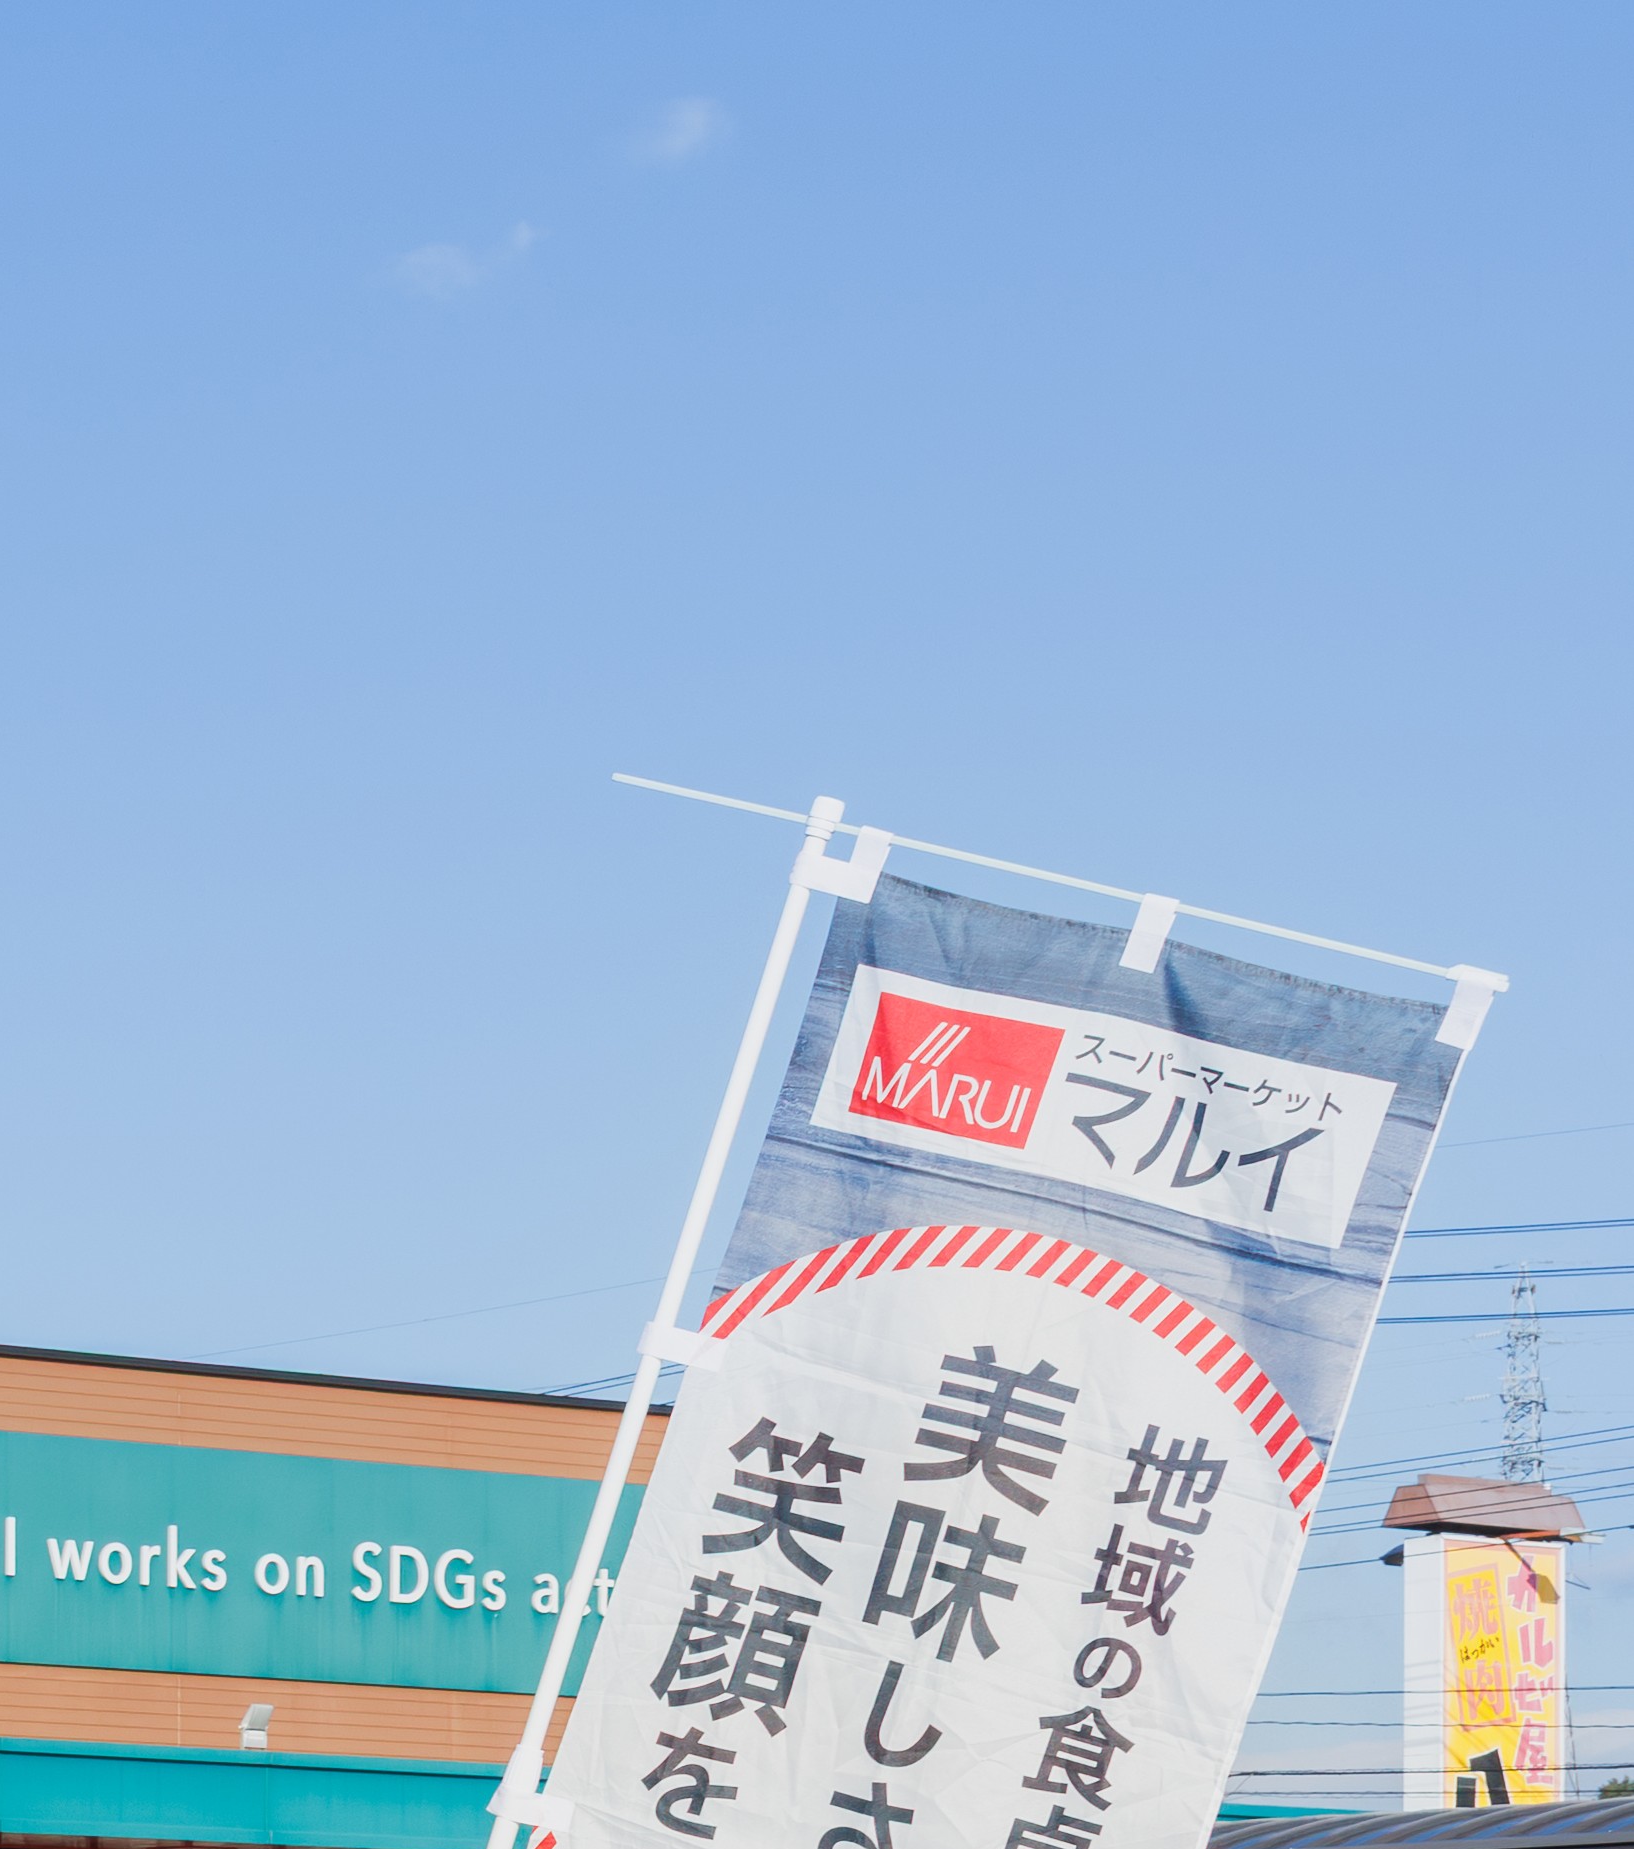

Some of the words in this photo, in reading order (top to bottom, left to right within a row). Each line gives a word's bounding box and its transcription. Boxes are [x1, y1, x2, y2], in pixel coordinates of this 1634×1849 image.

[861, 1054, 1031, 1134] MARUI
[1074, 1032, 1344, 1121] スーパーマーケット
[1065, 1069, 1326, 1213] マルイ
[48, 1525, 228, 1592] works
[255, 1549, 325, 1598] on
[351, 1541, 506, 1612] SDGs
[640, 1415, 866, 1842] 笑顔を
